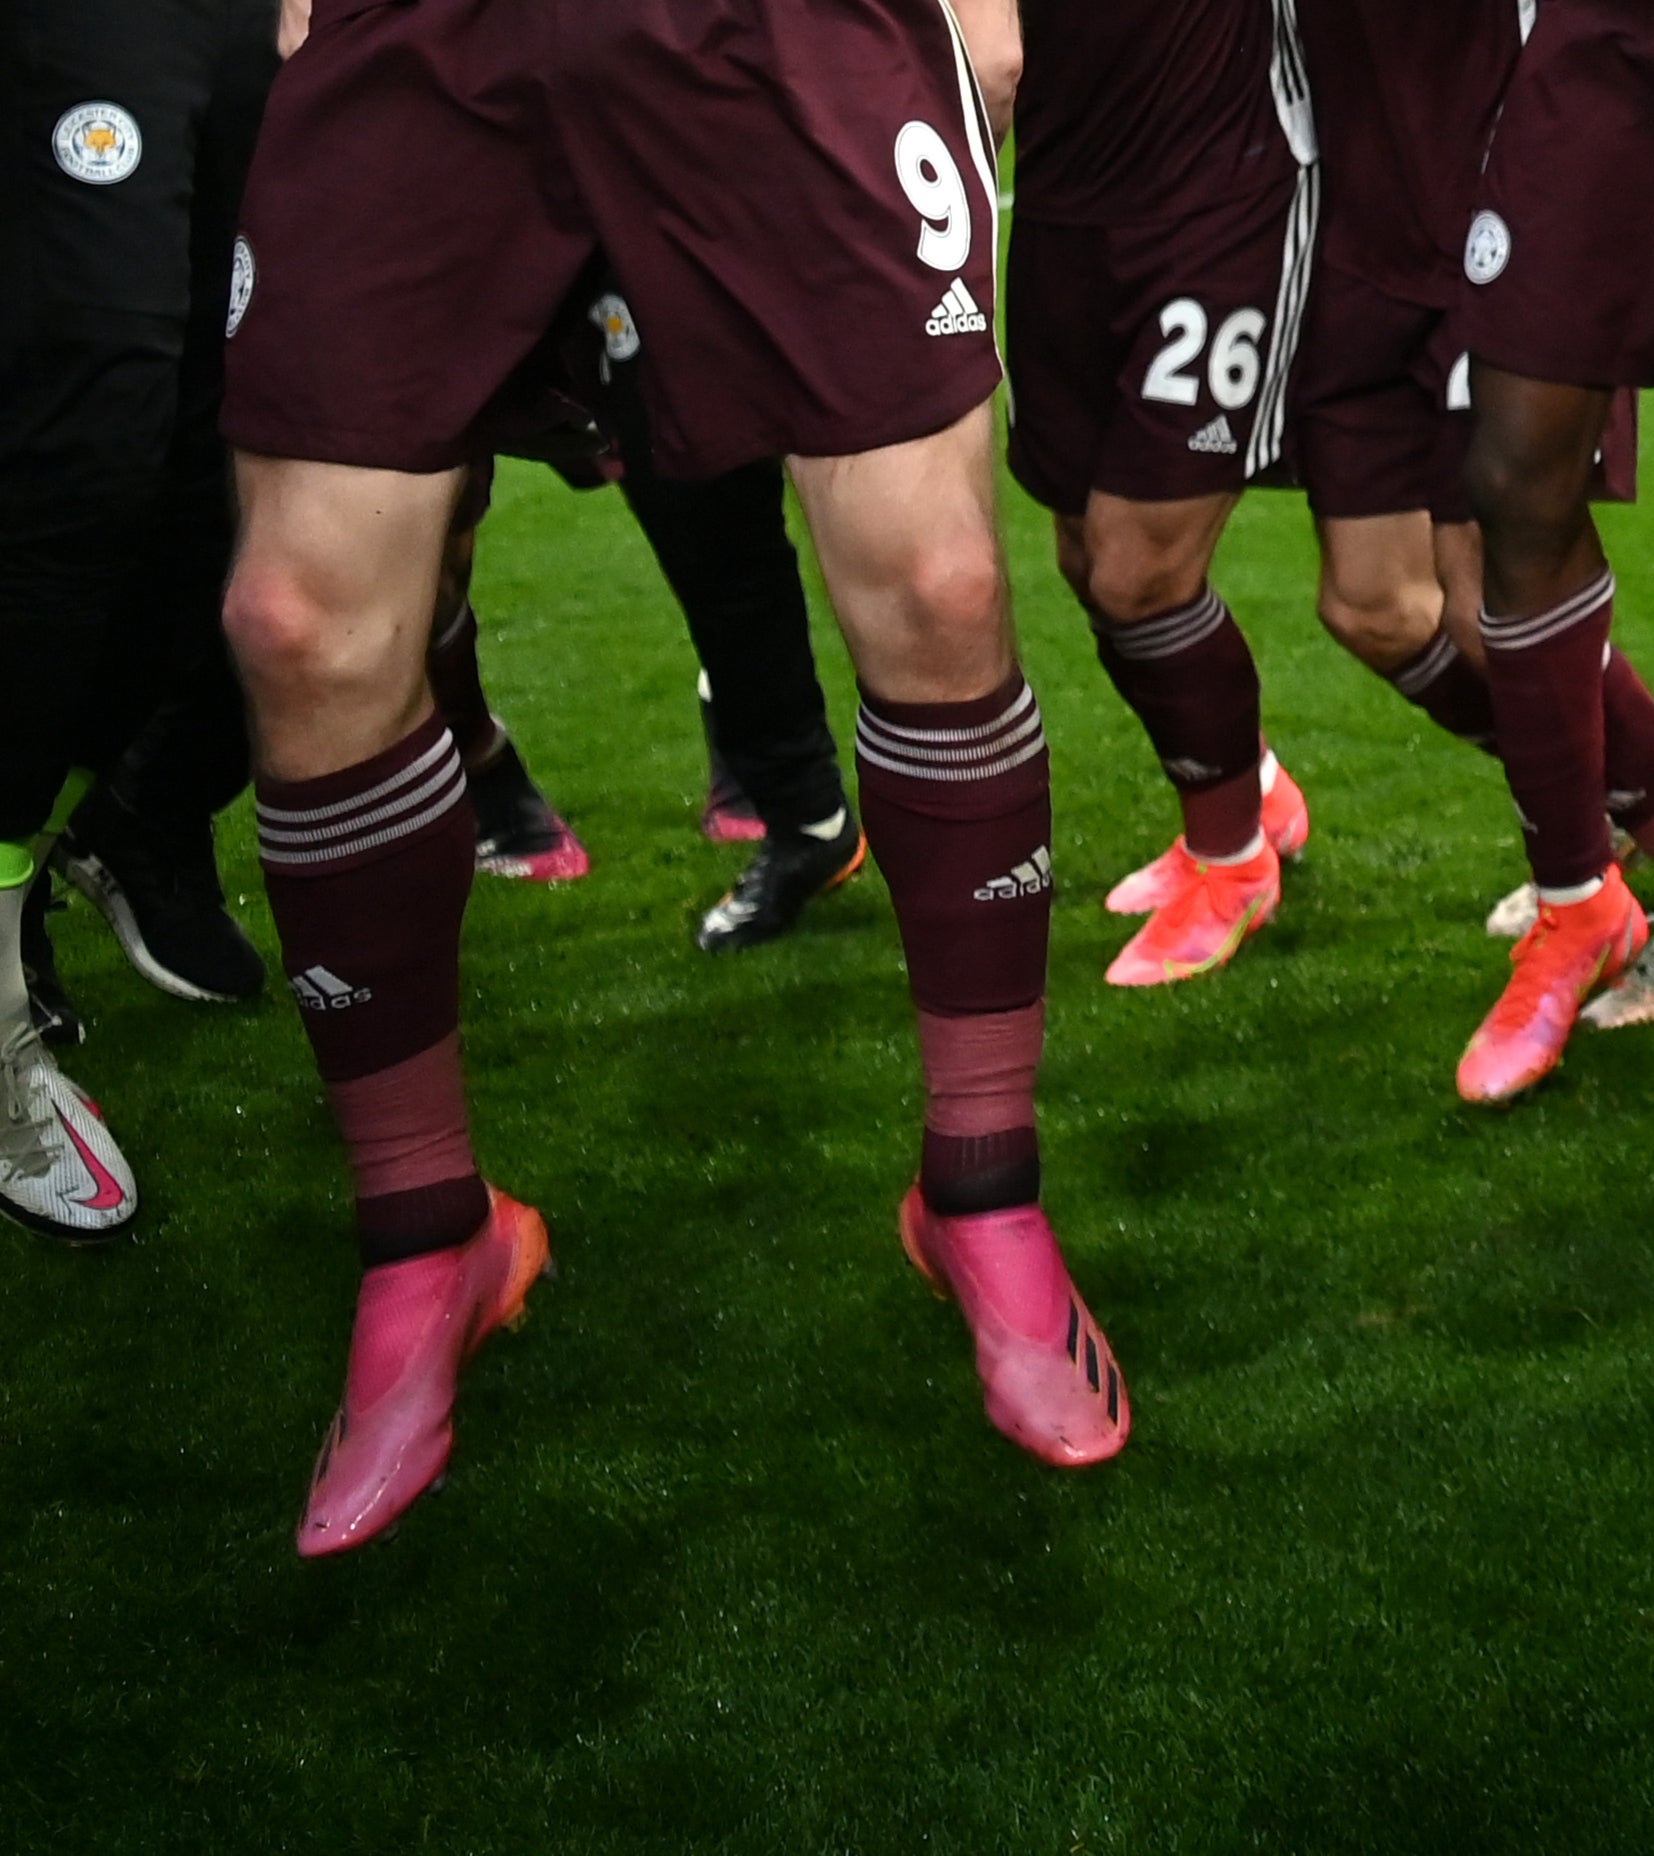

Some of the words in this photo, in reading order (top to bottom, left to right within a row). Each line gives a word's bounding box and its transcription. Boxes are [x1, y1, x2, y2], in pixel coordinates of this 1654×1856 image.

[894, 120, 971, 271] 9
[925, 312, 988, 337] adidas
[1141, 296, 1266, 410] 26
